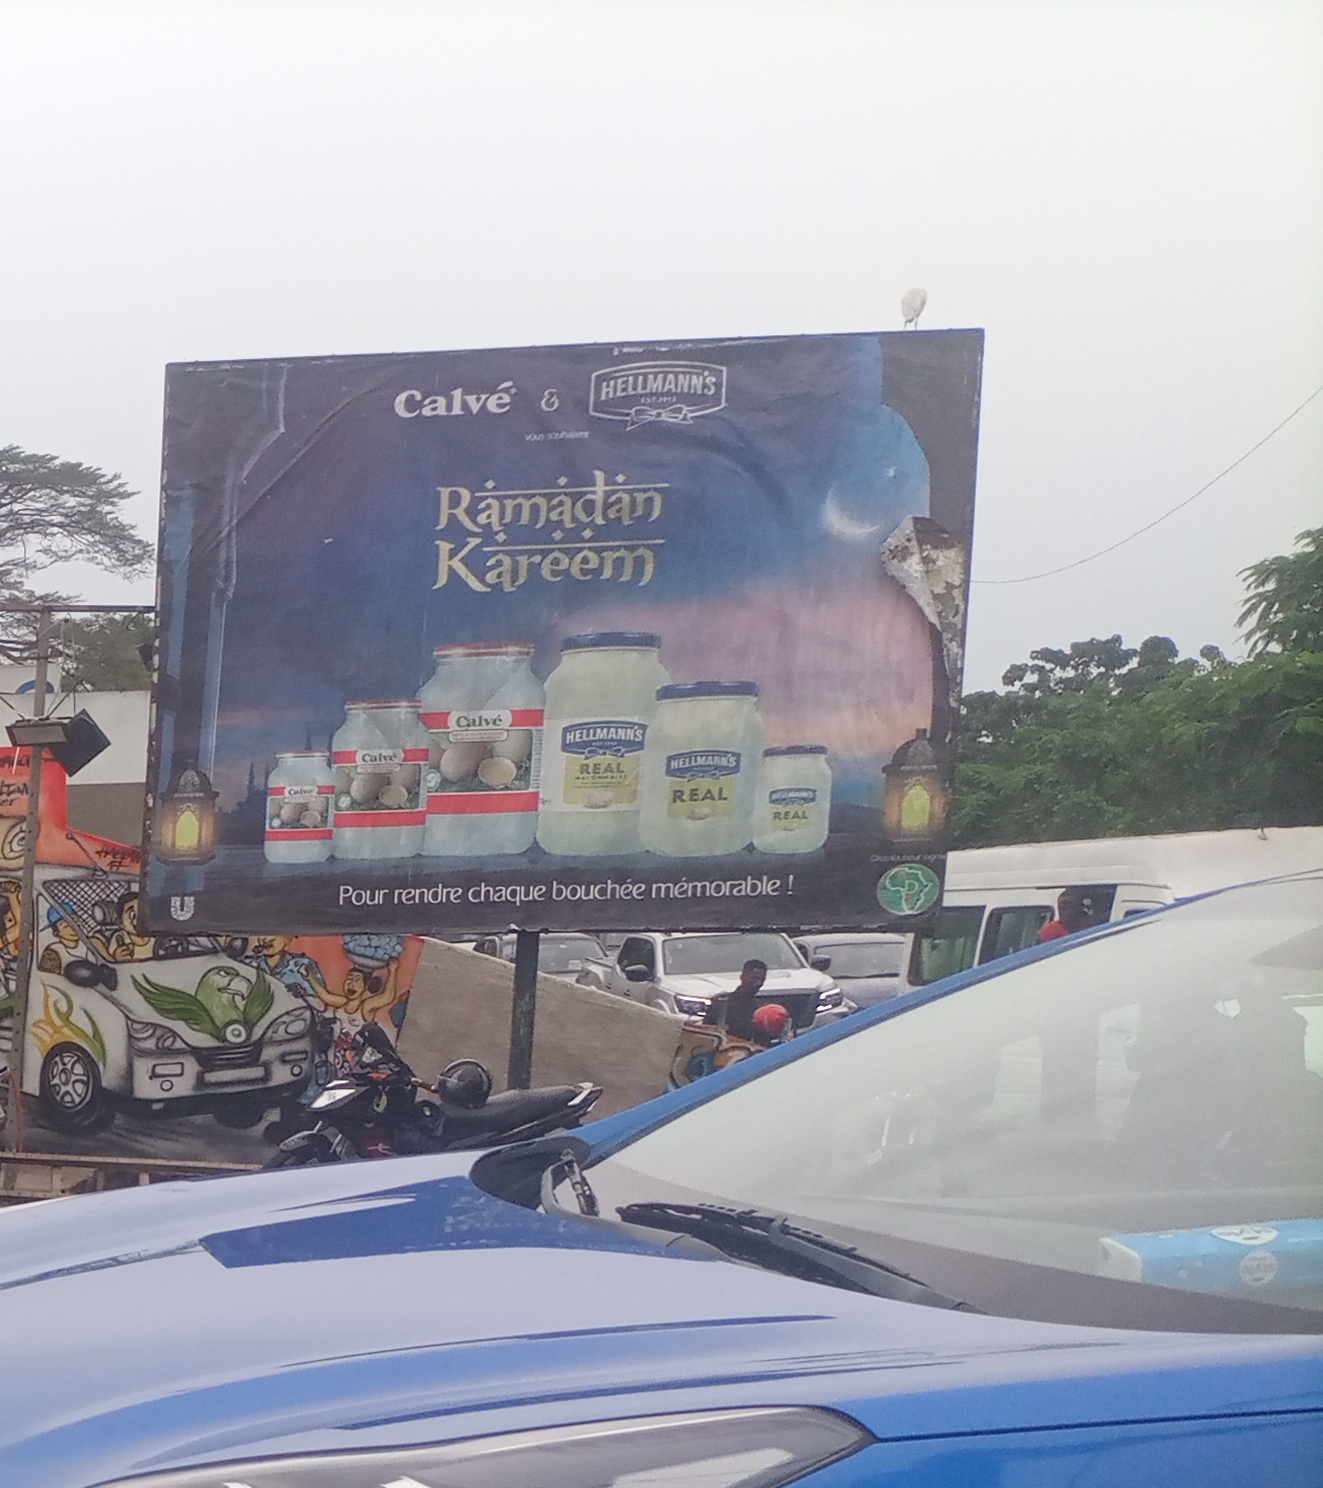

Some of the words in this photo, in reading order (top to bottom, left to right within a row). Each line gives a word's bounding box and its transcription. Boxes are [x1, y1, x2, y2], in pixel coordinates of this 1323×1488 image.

[394, 381, 516, 419] Calvé
[540, 388, 560, 412] &
[600, 370, 717, 401] HELLMANN'S
[434, 469, 671, 534] Ramadan
[431, 528, 666, 593] Kareem
[455, 714, 503, 728] Calvé
[565, 725, 645, 745] HELLMANN'S
[579, 762, 626, 775] REAL
[669, 753, 738, 770] HELLMANN'S
[671, 786, 730, 804] REAL
[772, 810, 809, 821] REAL
[339, 885, 388, 905] Pour
[393, 883, 461, 904] rendre
[467, 884, 545, 907] chaque
[552, 879, 646, 901] bouchée
[651, 875, 781, 899] mémorable
[786, 875, 793, 895] !
